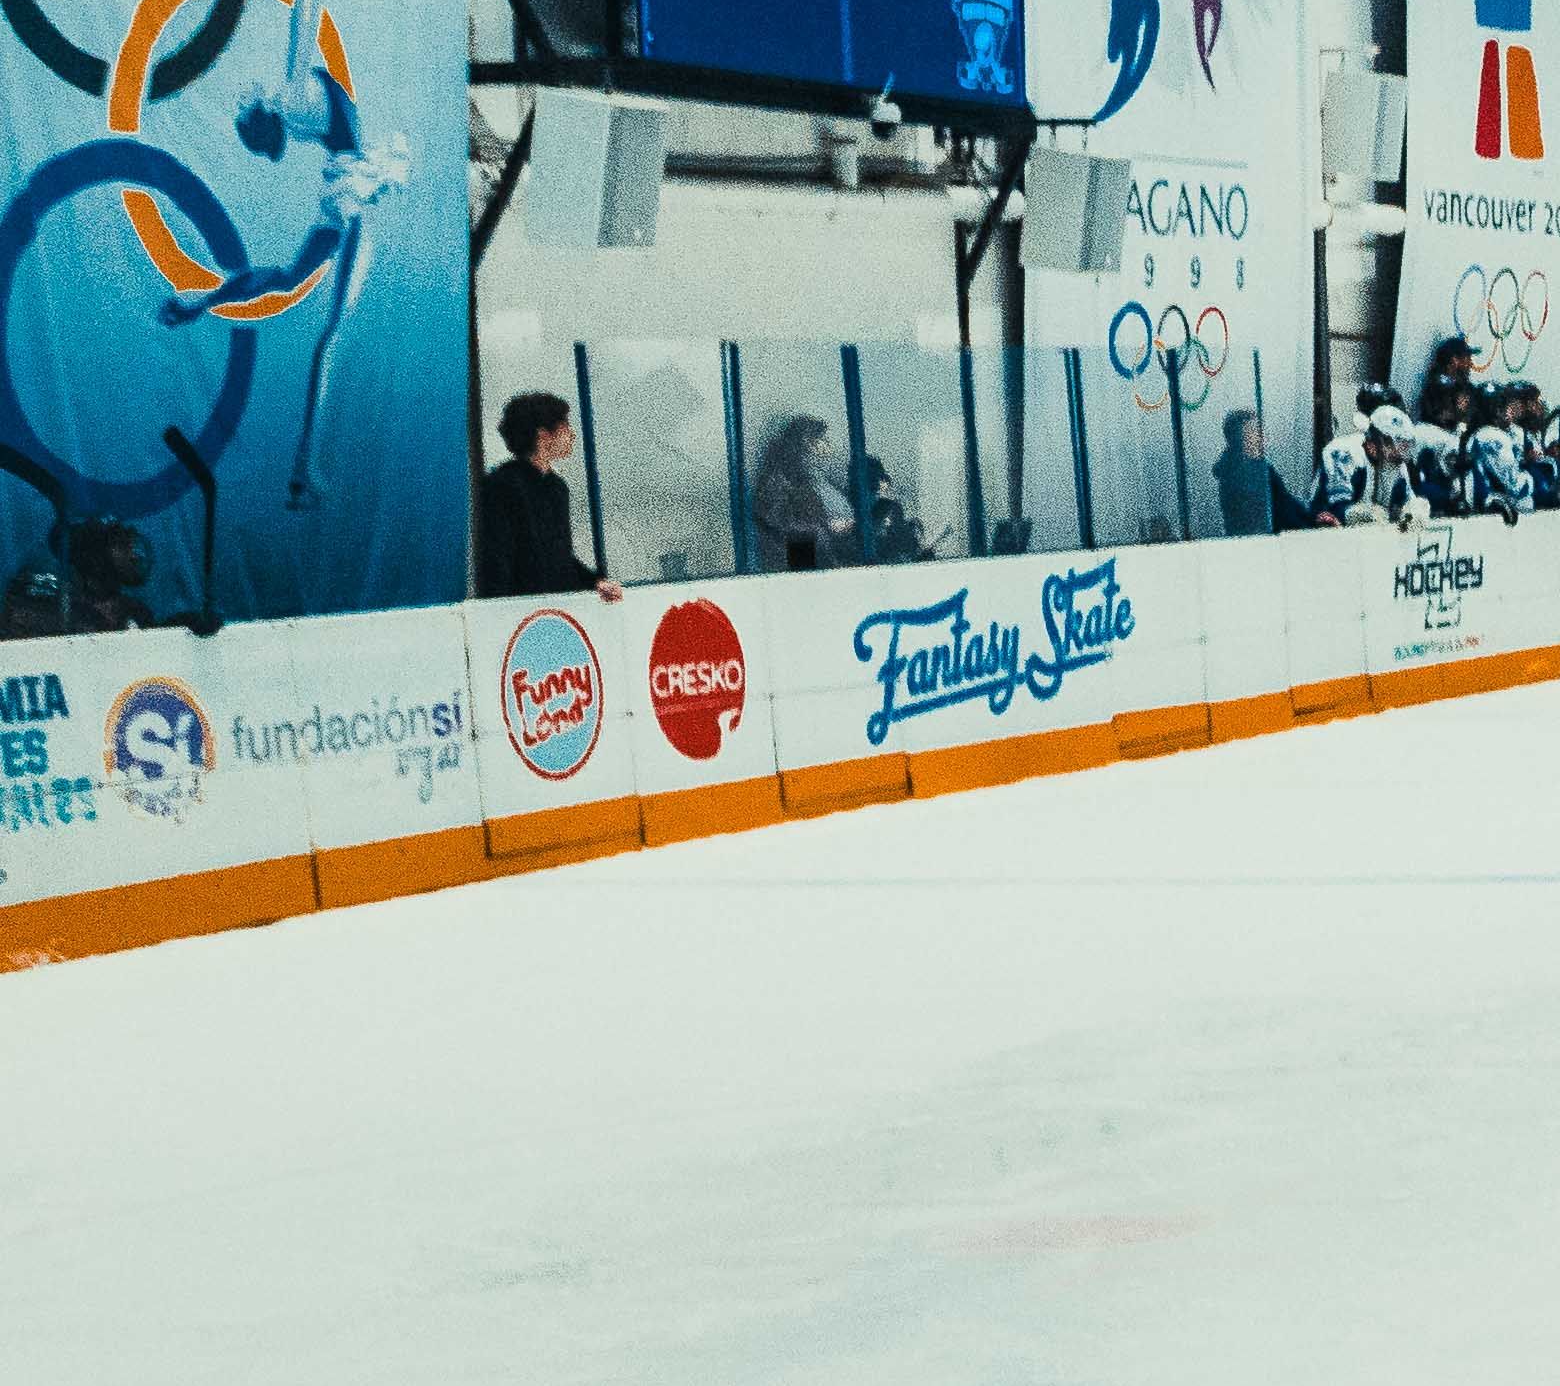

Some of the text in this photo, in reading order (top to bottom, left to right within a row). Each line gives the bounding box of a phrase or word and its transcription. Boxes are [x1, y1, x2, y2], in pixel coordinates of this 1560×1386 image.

[1126, 179, 1249, 240] AGANO
[1423, 188, 1537, 233] vancouver
[652, 658, 743, 698] CRESKO
[853, 557, 1136, 746] Fantasy Skate
[511, 663, 594, 716] Funny
